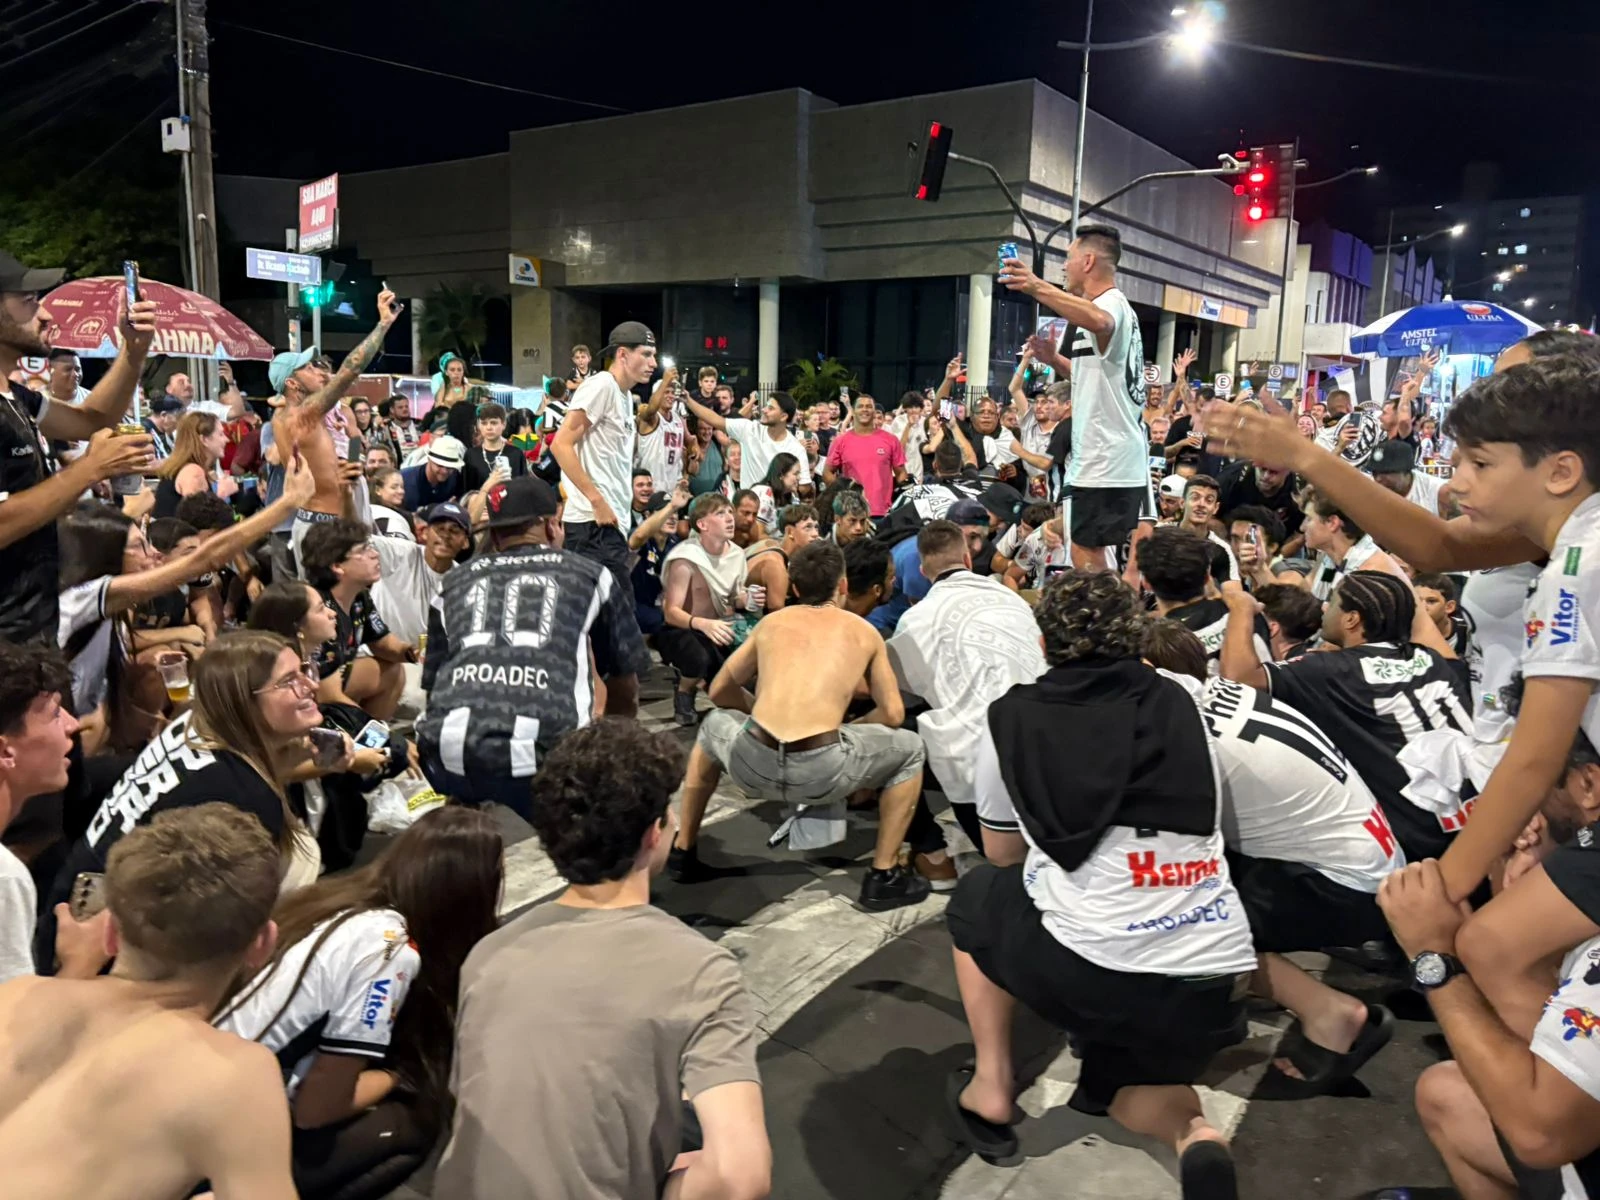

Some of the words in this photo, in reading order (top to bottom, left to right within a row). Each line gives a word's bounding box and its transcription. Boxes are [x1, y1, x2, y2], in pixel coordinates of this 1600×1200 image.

[1401, 328, 1438, 341] AMSTEL
[1405, 338, 1433, 347] ULTRA
[1219, 377, 1227, 386] E
[668, 451, 675, 465] 6
[460, 573, 560, 649] 10
[1550, 588, 1575, 646] Vitor
[451, 662, 550, 690] PROADEC
[364, 979, 391, 1030] Vitor
